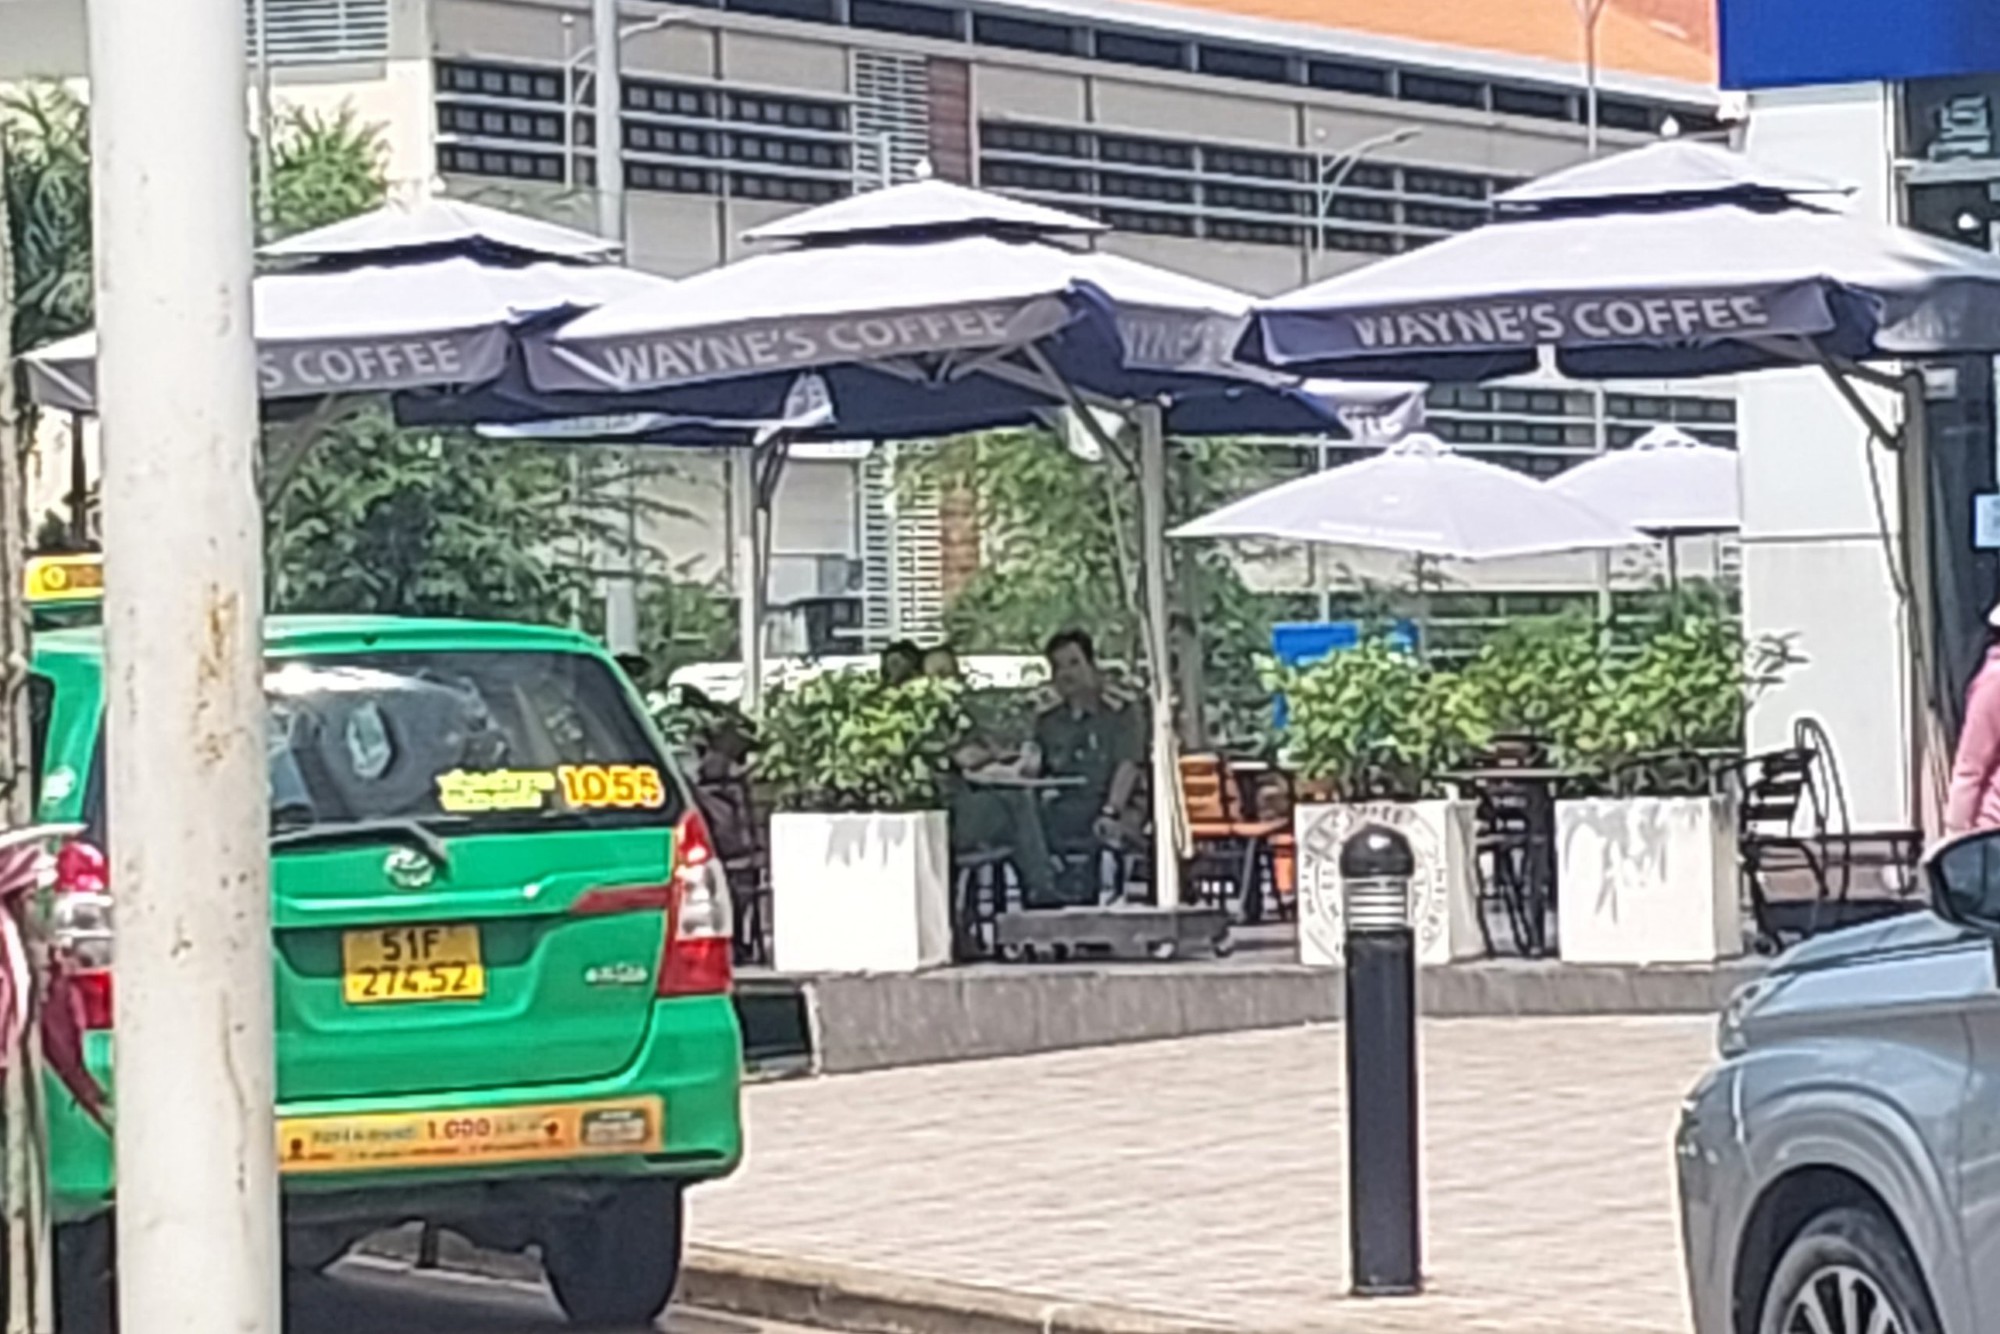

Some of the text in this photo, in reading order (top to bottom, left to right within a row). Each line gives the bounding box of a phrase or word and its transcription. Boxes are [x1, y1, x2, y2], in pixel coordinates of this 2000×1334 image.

[1354, 301, 1564, 346] WAYNE'S
[292, 339, 462, 385] COFFEE
[605, 306, 1008, 383] WAYNE'S COFFEE
[562, 769, 662, 805] 1055
[382, 928, 440, 961] 51F
[358, 962, 469, 996] 274.52
